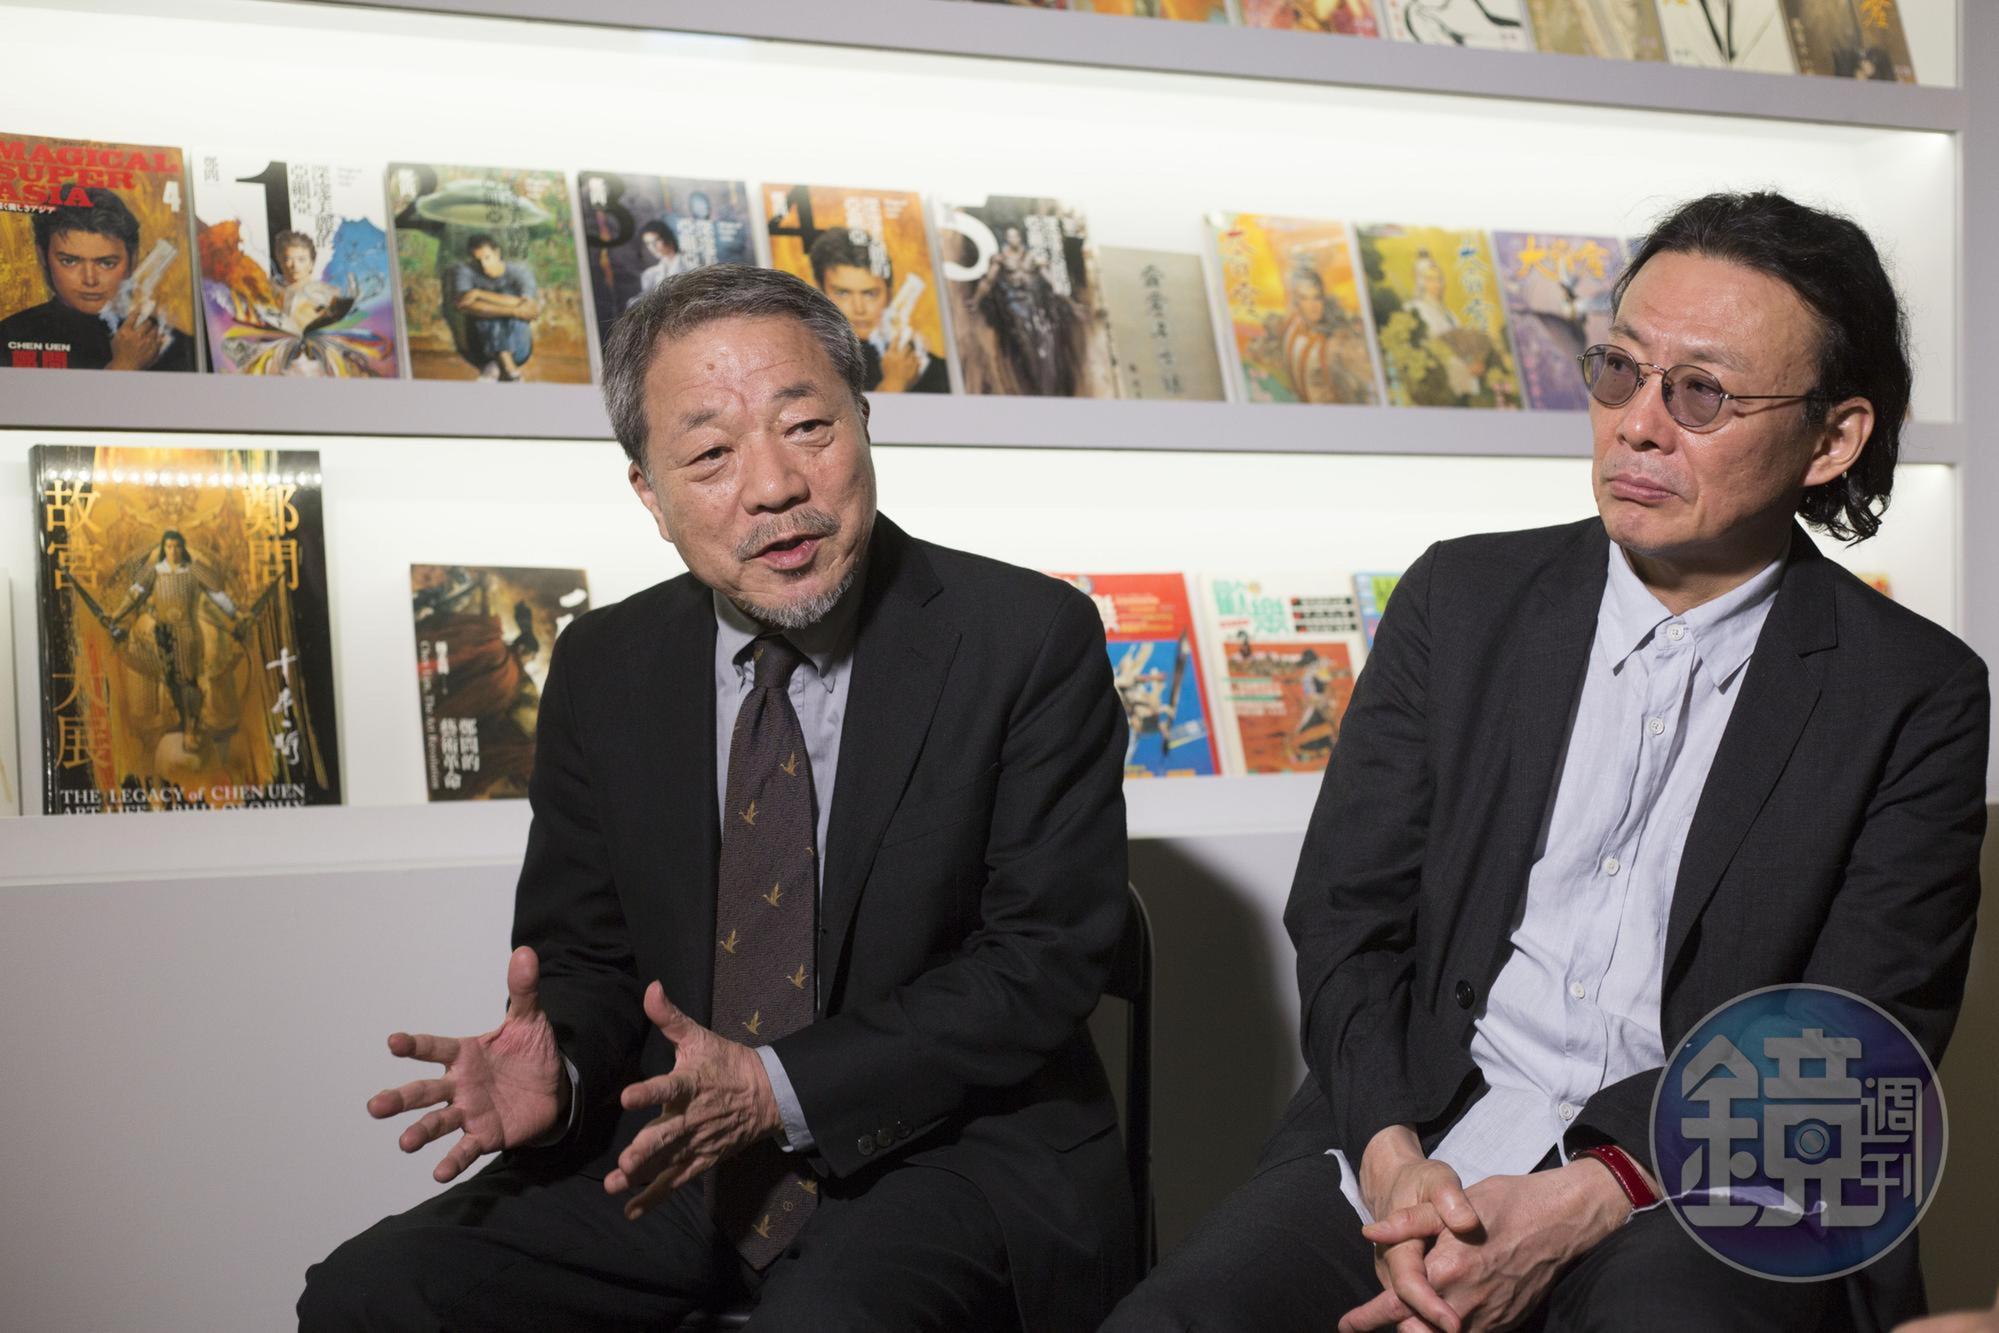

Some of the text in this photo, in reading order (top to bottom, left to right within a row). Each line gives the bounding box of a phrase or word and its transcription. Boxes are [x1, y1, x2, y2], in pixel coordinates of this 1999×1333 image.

[0, 141, 178, 173] MAGICAL
[0, 163, 136, 190] SUPER
[0, 180, 95, 207] ASIA
[162, 180, 182, 213] 4
[7, 341, 71, 352] CHEN UEN
[45, 479, 103, 590] 故宮
[243, 483, 300, 591] 鄭問
[60, 782, 306, 805] THE LEGACY of CHEN UEN
